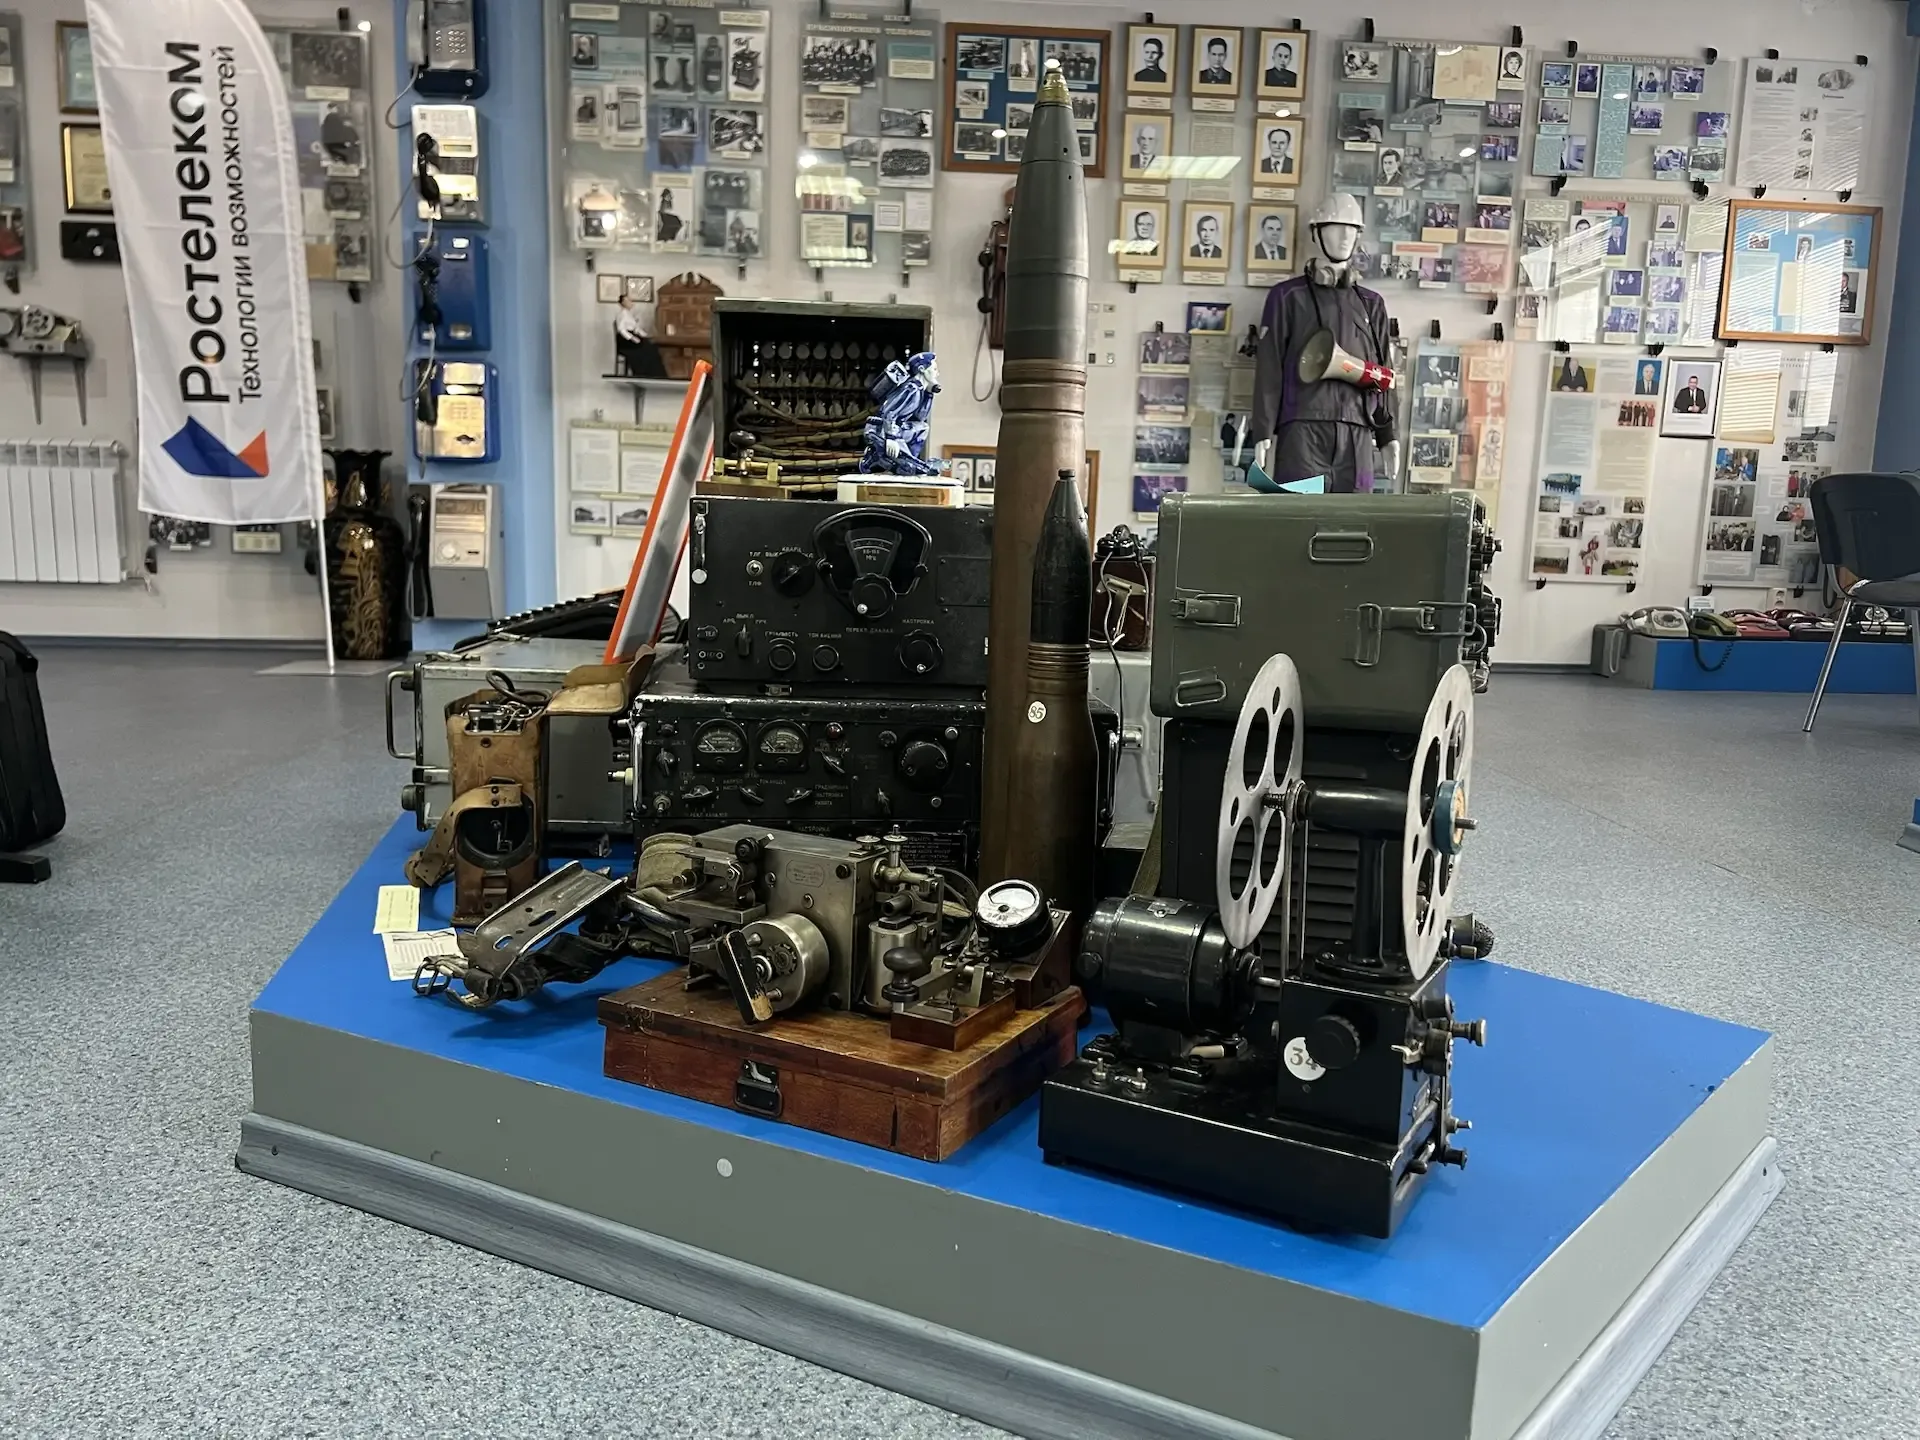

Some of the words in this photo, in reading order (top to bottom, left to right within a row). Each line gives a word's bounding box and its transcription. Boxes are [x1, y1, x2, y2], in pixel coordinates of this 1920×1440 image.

[210, 45, 250, 247] возможностей
[165, 42, 231, 404] Ростелеком
[232, 255, 263, 405] Технологии
[1029, 705, 1044, 720] 85
[1289, 1046, 1319, 1072] 34
